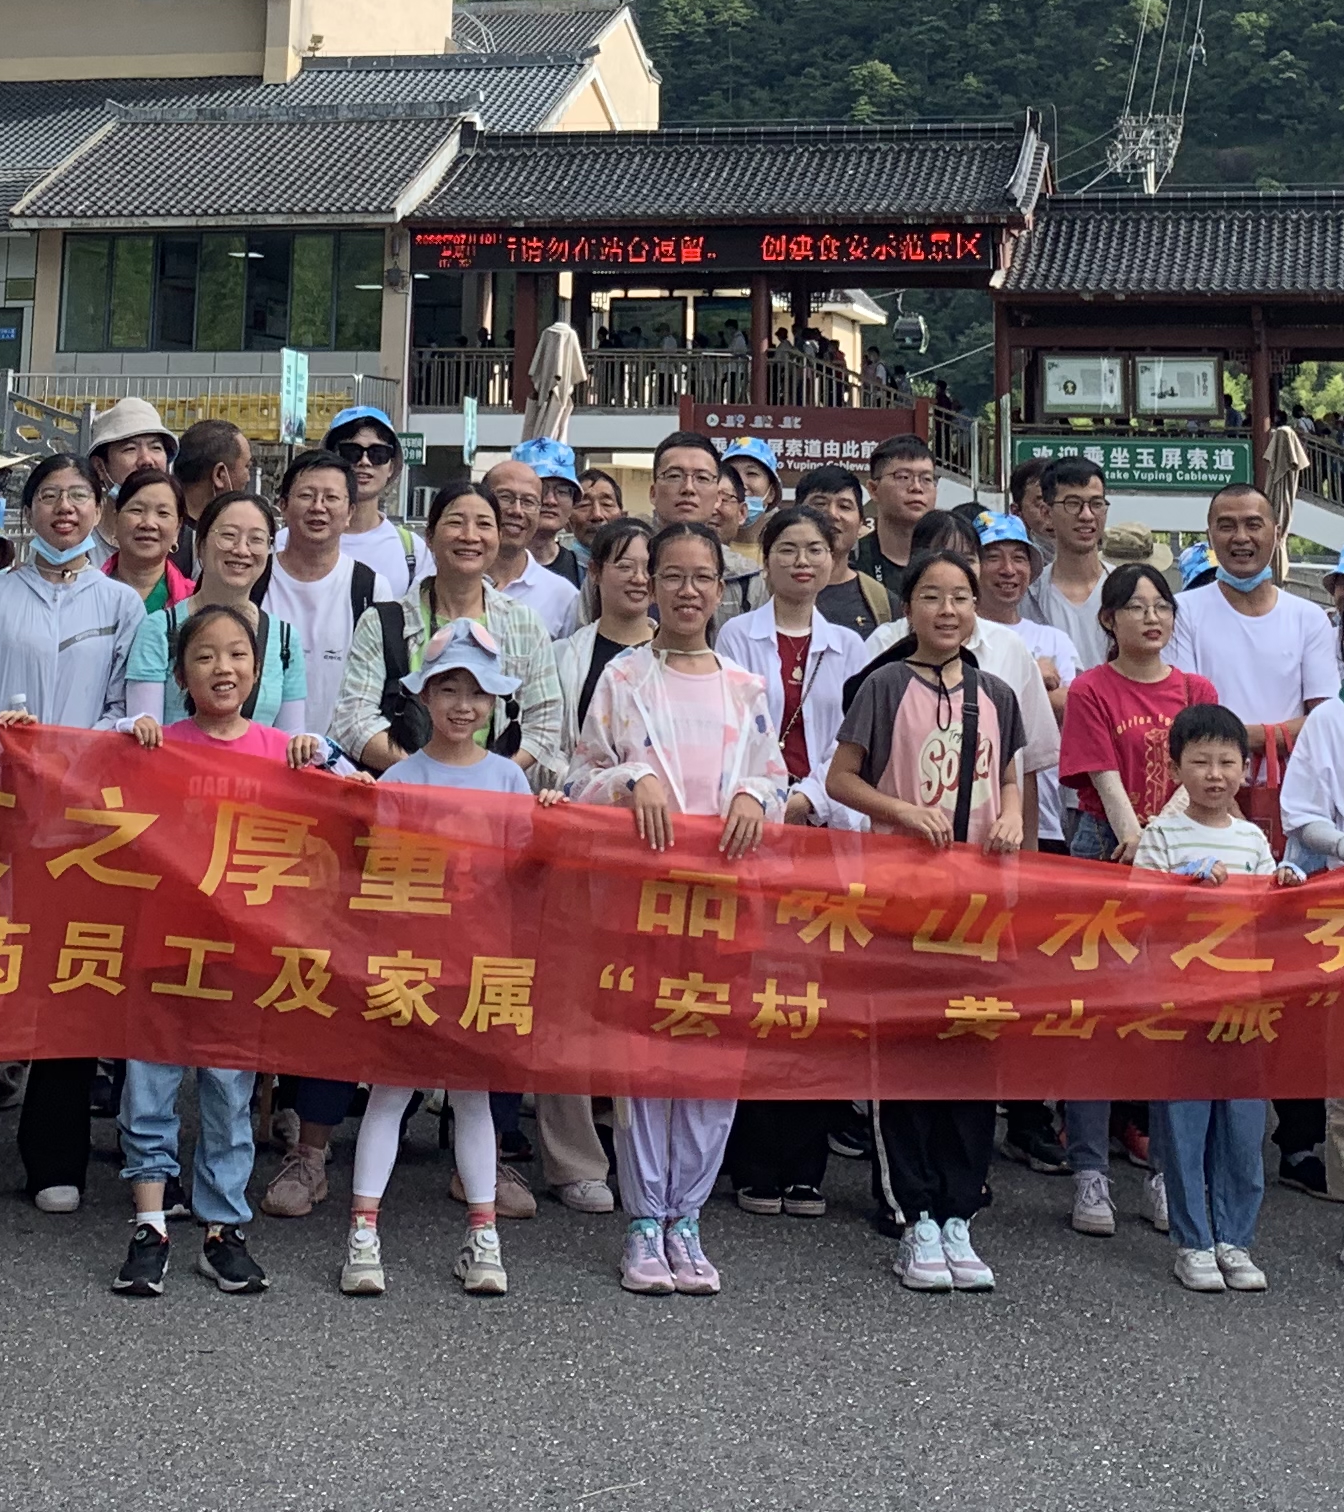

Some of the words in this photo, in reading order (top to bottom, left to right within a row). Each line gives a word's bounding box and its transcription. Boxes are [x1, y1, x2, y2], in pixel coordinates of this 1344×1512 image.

[710, 437, 878, 459] 乘屏索道由此前
[786, 459, 824, 472] Yuping
[1133, 470, 1173, 483] Yuping
[1176, 470, 1232, 483] Cableway
[919, 733, 993, 805] Soa
